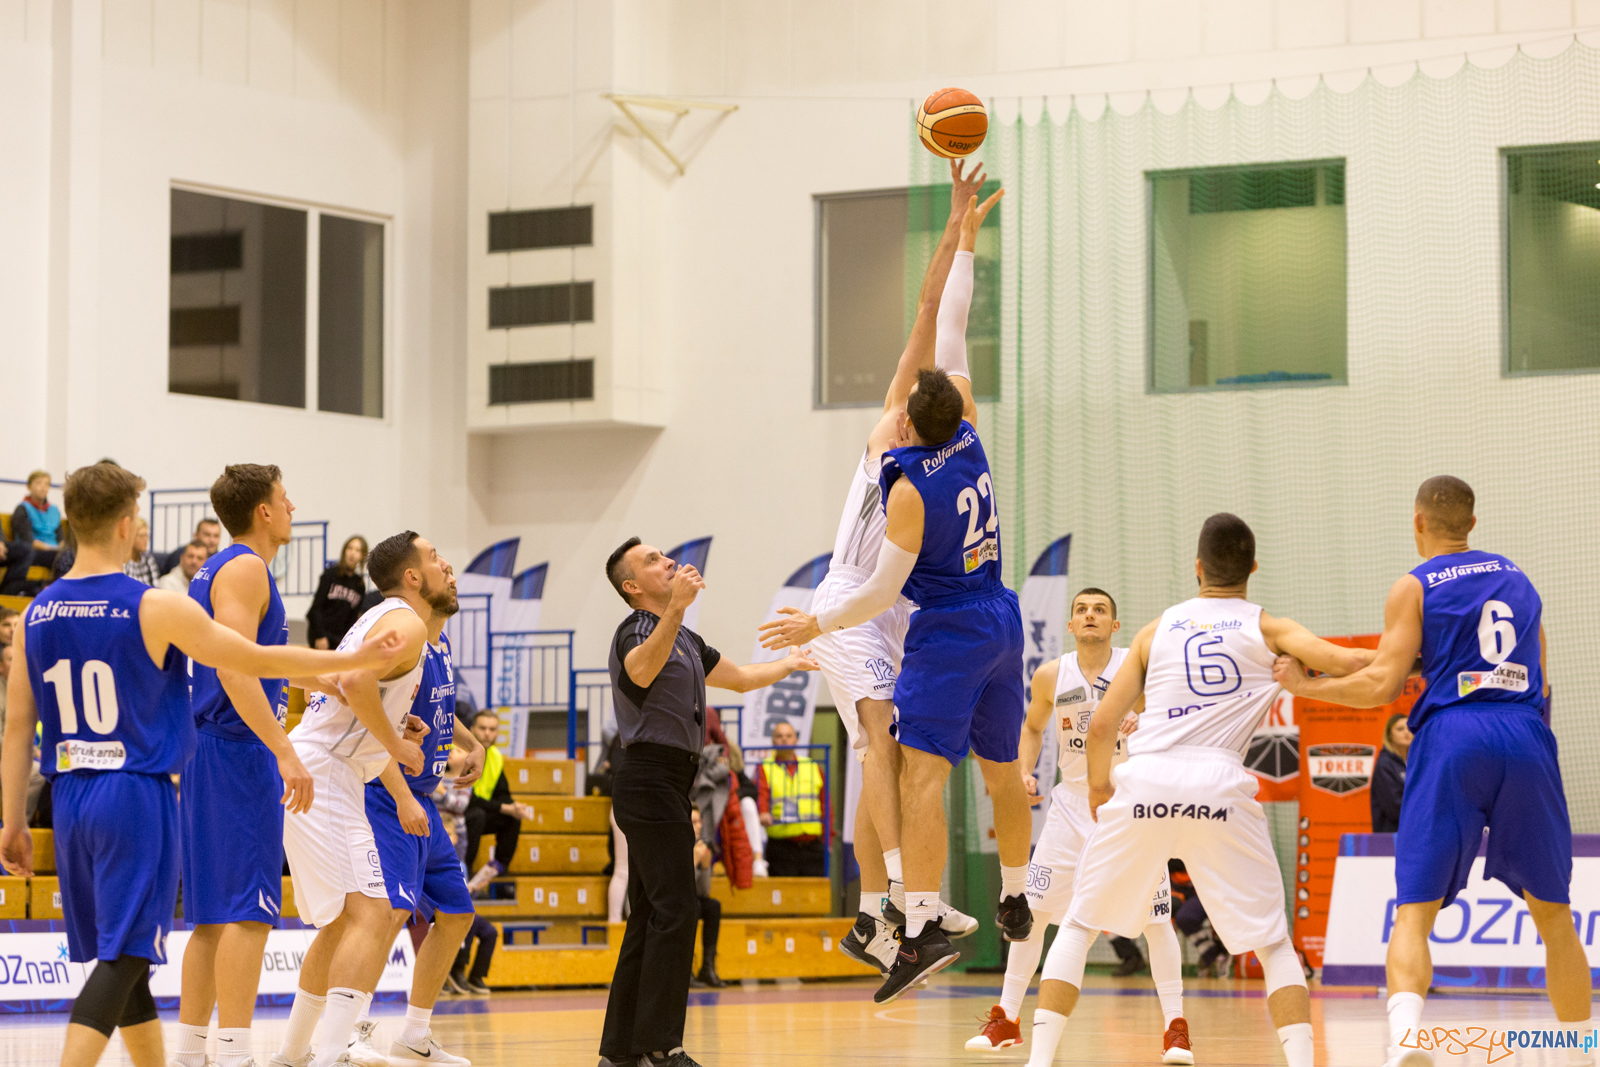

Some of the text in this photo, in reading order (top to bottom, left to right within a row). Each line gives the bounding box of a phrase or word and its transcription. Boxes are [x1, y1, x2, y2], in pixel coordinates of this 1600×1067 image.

[921, 432, 975, 474] Polfarmex
[957, 472, 998, 549] 22
[1426, 562, 1502, 585] Polfarmex
[29, 600, 108, 622] Polfarmex
[1478, 600, 1517, 665] 6
[865, 658, 897, 681] 12
[1185, 631, 1242, 697] 6
[43, 659, 119, 735] 10
[70, 744, 124, 758] drukarnia
[1318, 760, 1364, 774] JOKER
[1133, 802, 1228, 822] BIOFARM
[367, 850, 382, 877] 9
